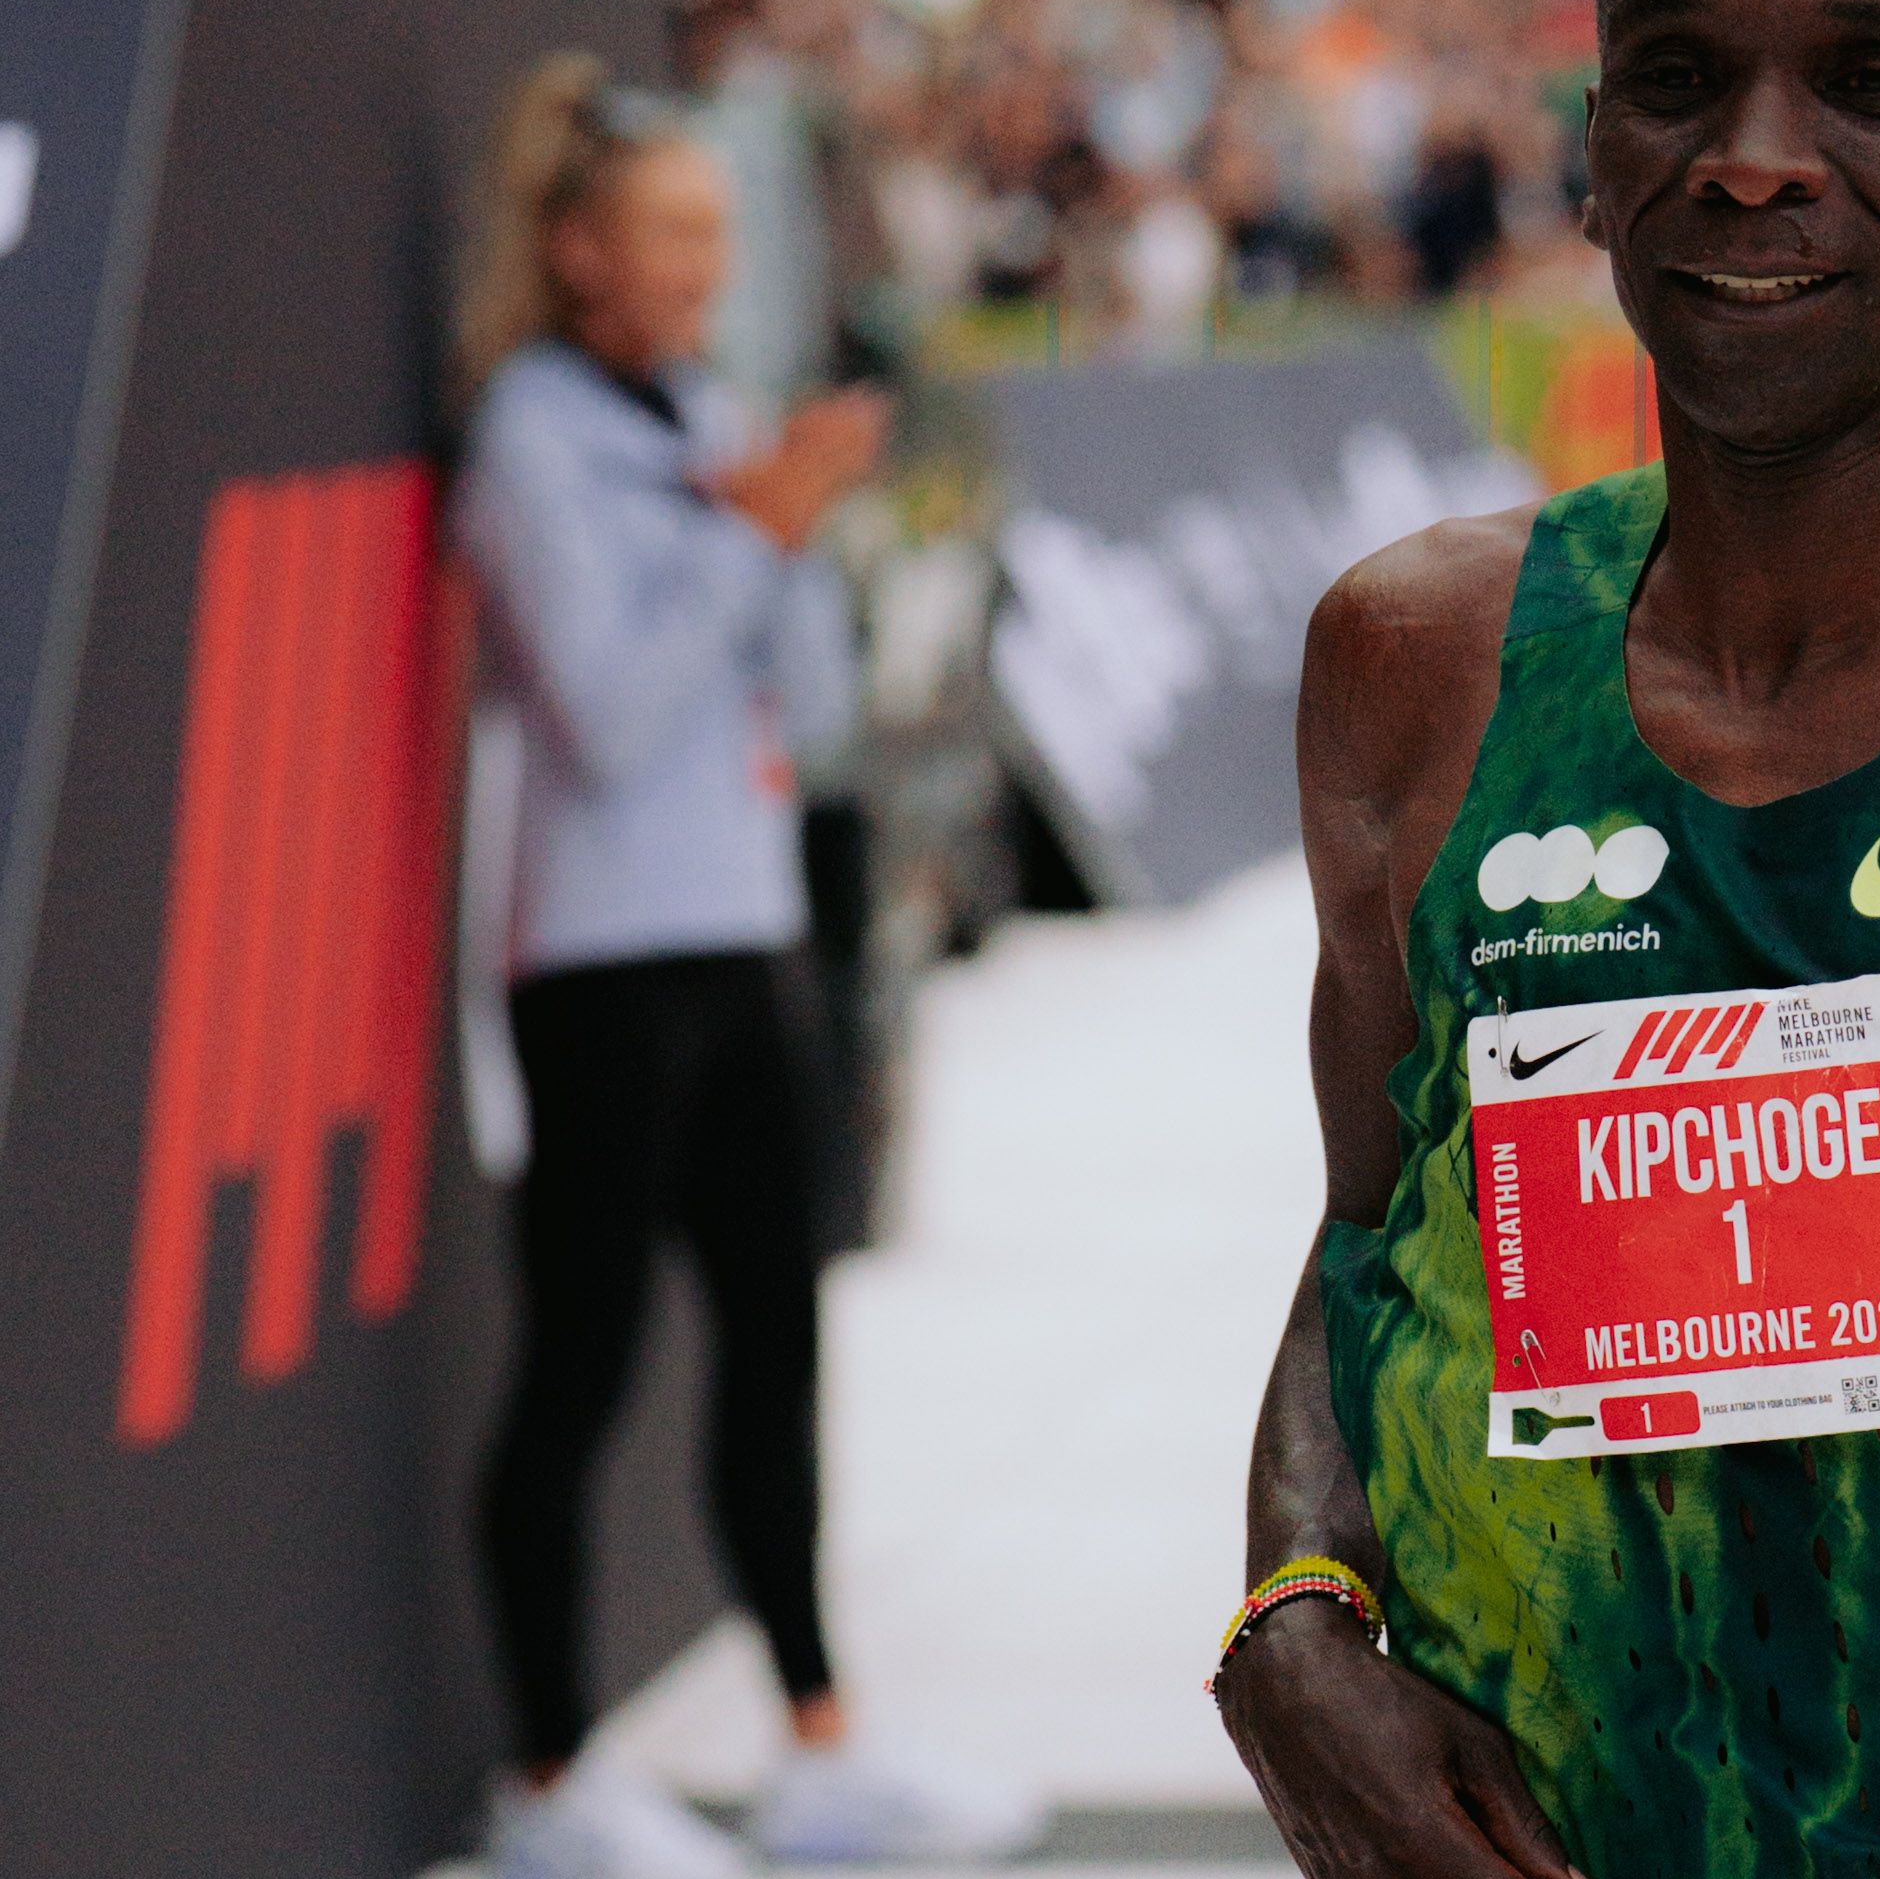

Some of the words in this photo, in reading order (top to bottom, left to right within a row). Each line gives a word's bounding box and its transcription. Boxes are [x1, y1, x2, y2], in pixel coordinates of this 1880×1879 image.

[1471, 923, 1660, 966] dsm-firmenich
[1778, 1006, 1874, 1031] MELBOURNE
[1781, 1025, 1866, 1049] MARATHON
[1782, 1048, 1831, 1064] FESTIVAL
[1492, 1142, 1526, 1300] MARATHON
[1721, 1199, 1753, 1285] 1
[1584, 1306, 1814, 1371] MELBOURNE
[1640, 1402, 1652, 1434] 1
[1703, 1404, 1728, 1415] PLEASE
[1730, 1401, 1756, 1412] ATTACH
[1757, 1400, 1766, 1409] TO
[1767, 1399, 1783, 1408] YOUR
[1785, 1396, 1818, 1406] CLOTHING
[1819, 1394, 1833, 1404] BAG
